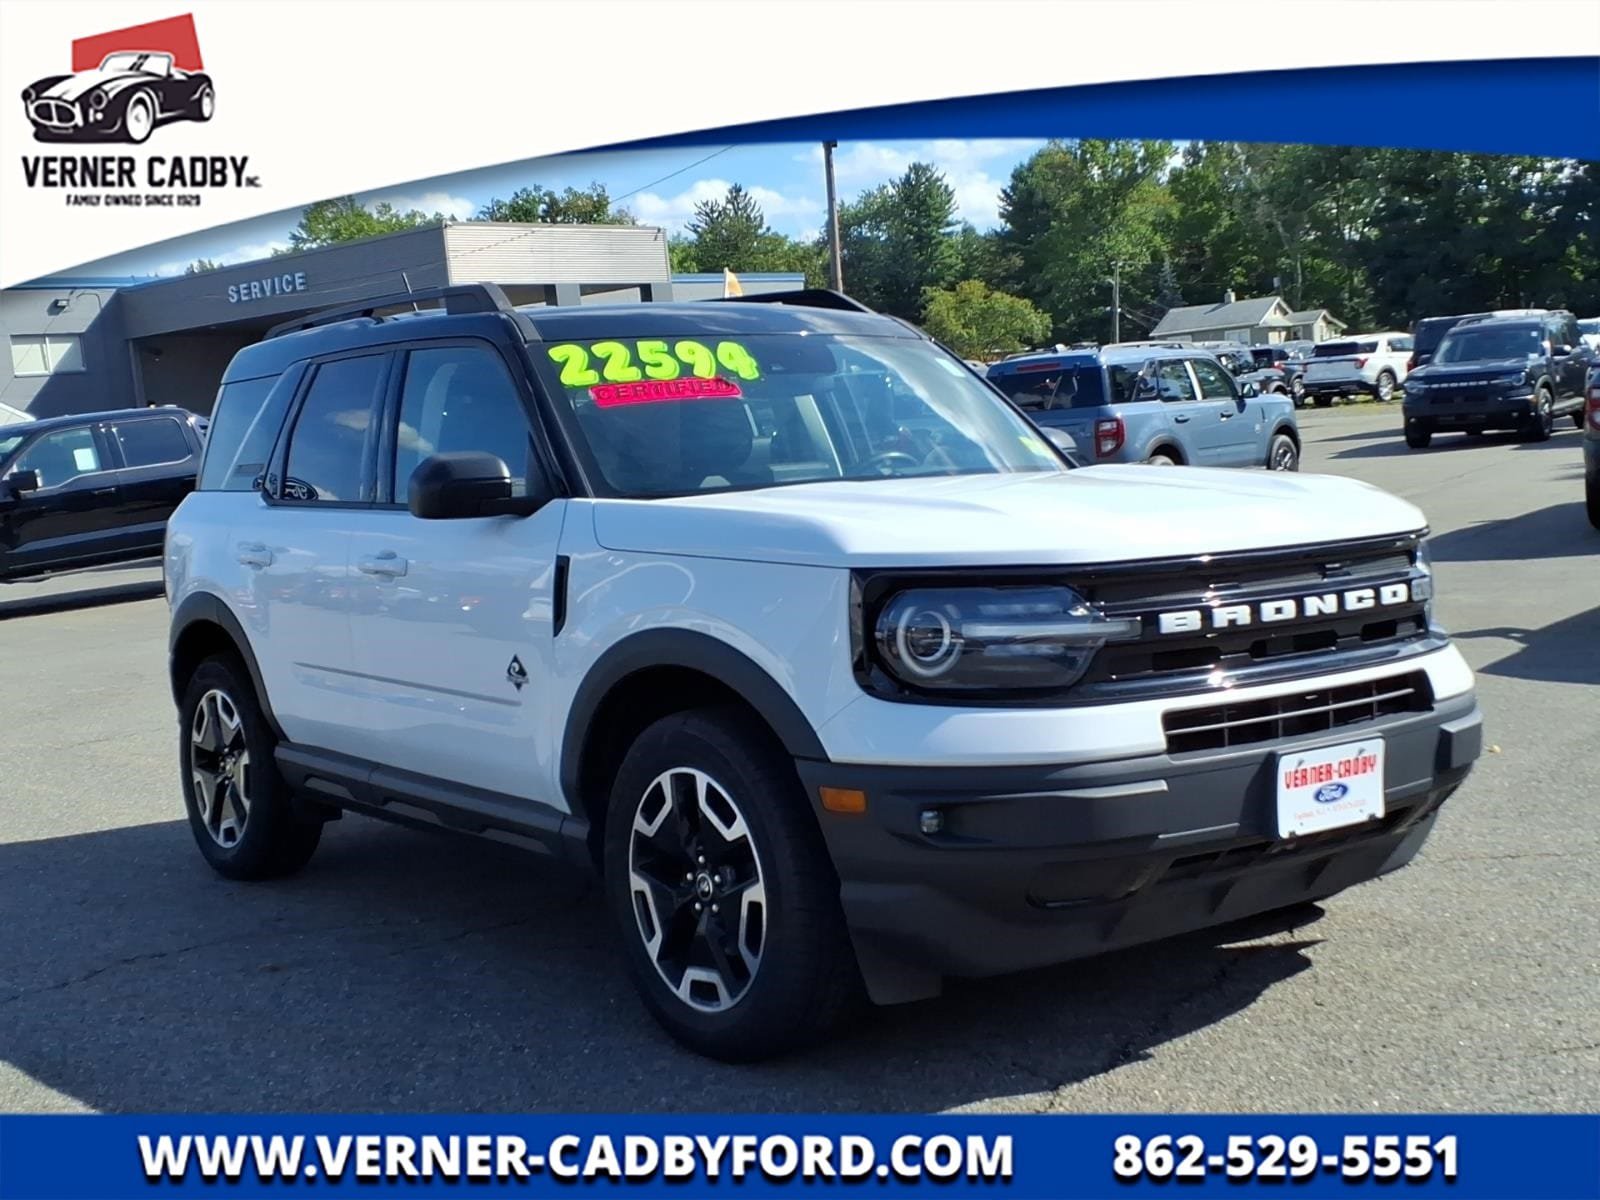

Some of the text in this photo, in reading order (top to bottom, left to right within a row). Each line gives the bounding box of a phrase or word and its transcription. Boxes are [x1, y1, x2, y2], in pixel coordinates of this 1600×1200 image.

[228, 272, 306, 303] SERVICE
[548, 340, 759, 386] 22594
[598, 379, 732, 400] CERTIFIED
[1159, 583, 1409, 634] BRONCO
[1285, 754, 1377, 789] VERNER-CADBY
